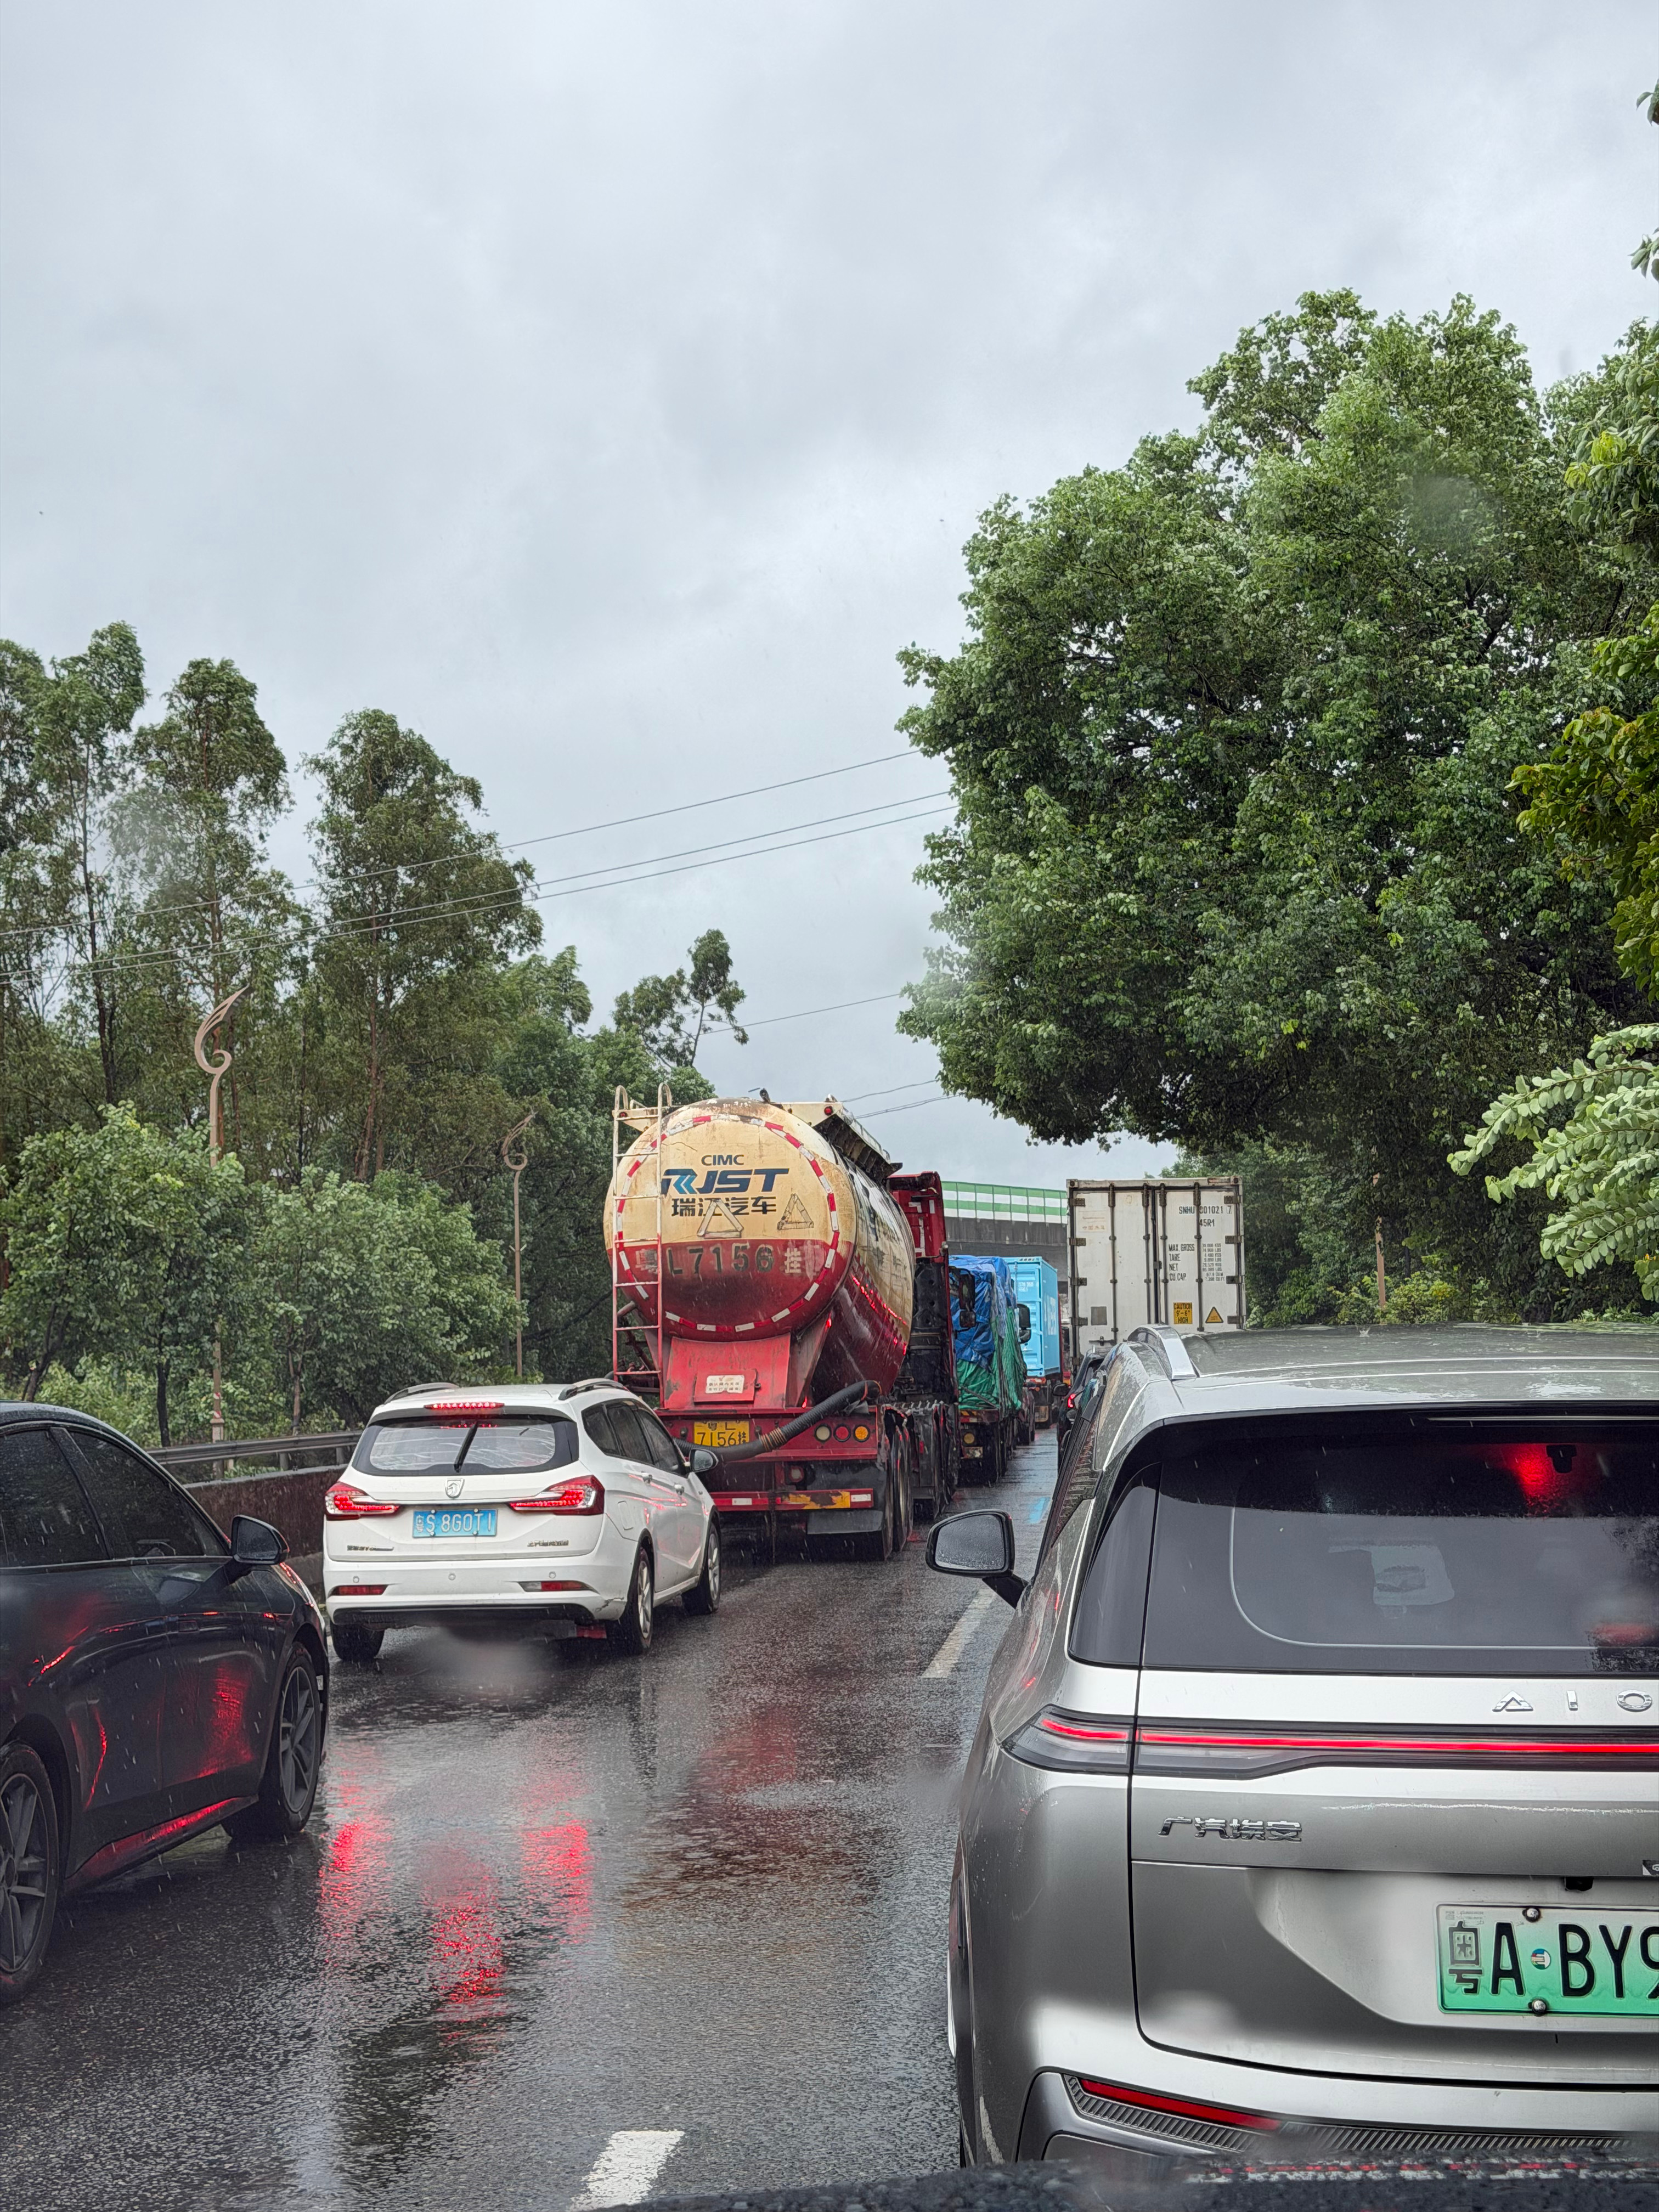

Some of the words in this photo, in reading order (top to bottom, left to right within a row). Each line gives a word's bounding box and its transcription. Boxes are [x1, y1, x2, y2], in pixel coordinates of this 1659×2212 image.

[701, 1154, 744, 1166] CIMC
[671, 1196, 777, 1217] 瑞江汽车
[1169, 1263, 1178, 1271] NET
[1158, 1816, 1302, 1843] 广汽埃安
